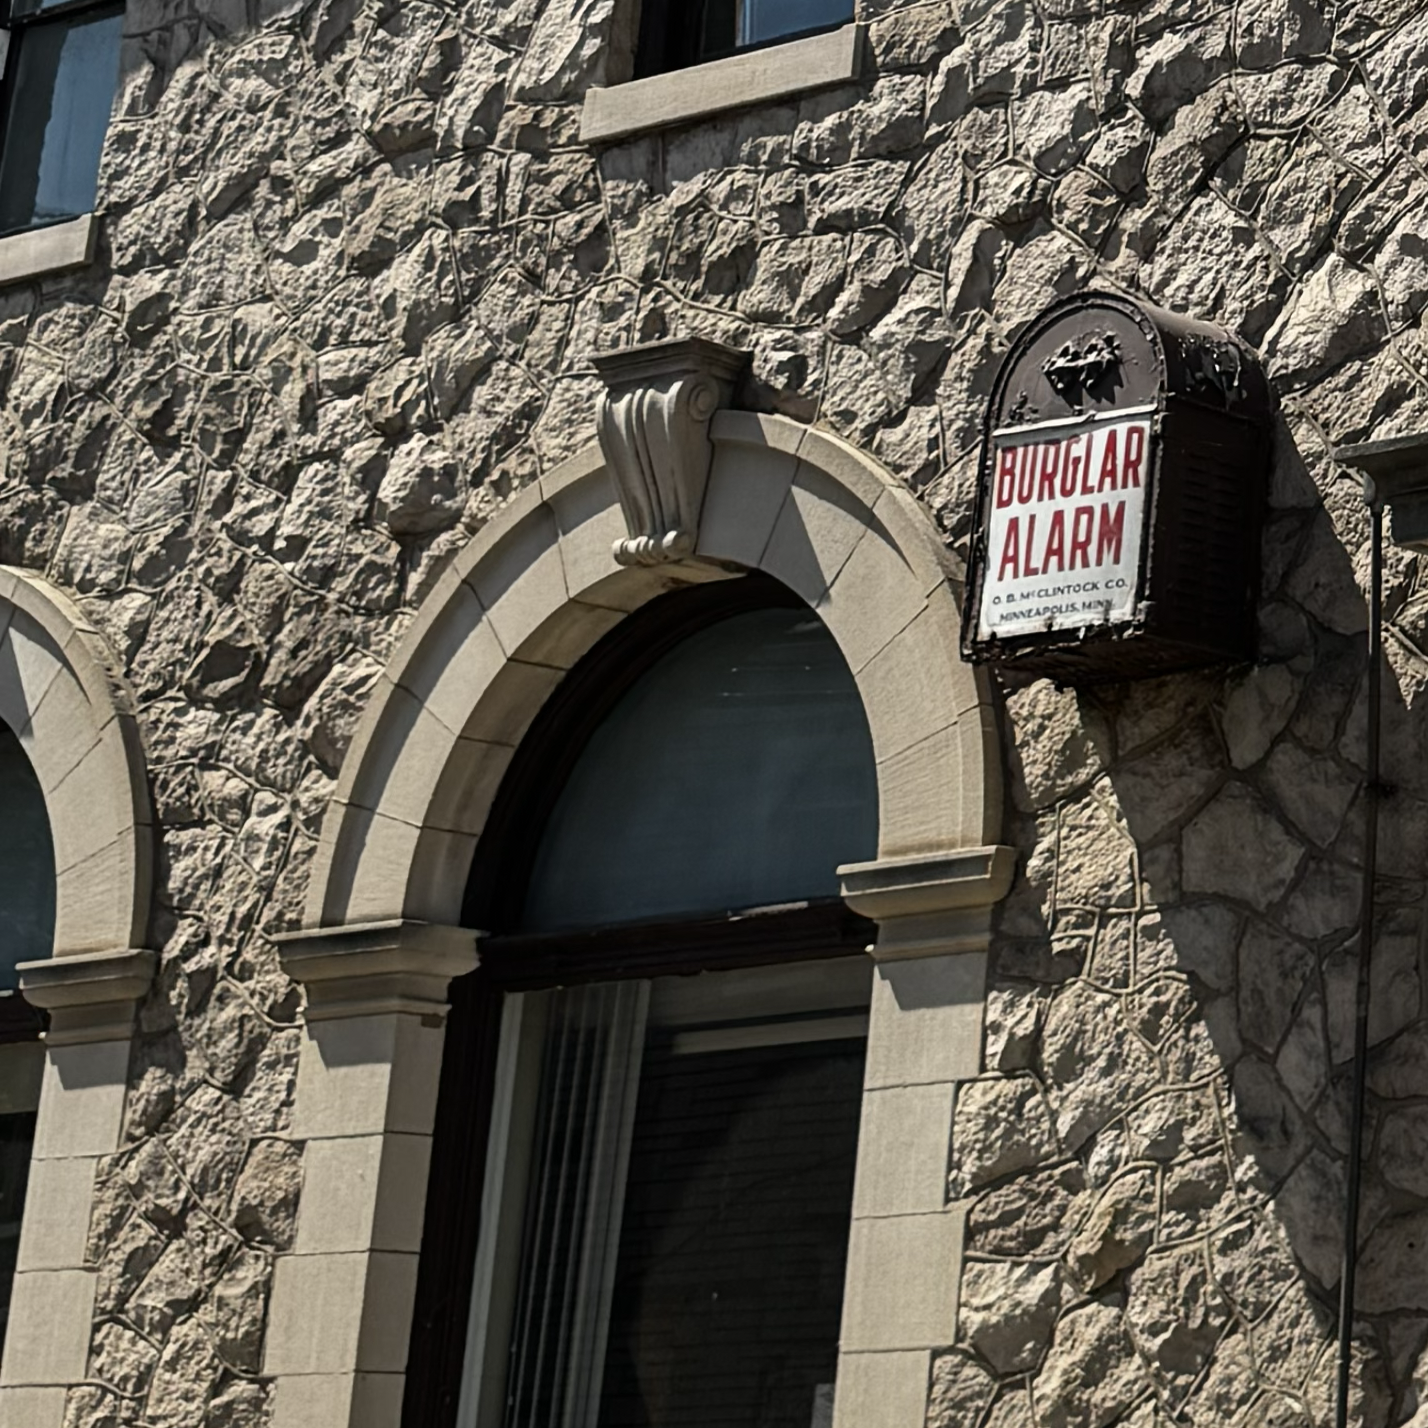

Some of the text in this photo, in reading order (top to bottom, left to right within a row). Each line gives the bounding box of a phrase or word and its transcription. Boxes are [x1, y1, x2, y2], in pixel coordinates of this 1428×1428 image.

[996, 425, 1146, 510] BURGLAR
[996, 500, 1126, 582] ALARM
[1105, 578, 1129, 590] CO.
